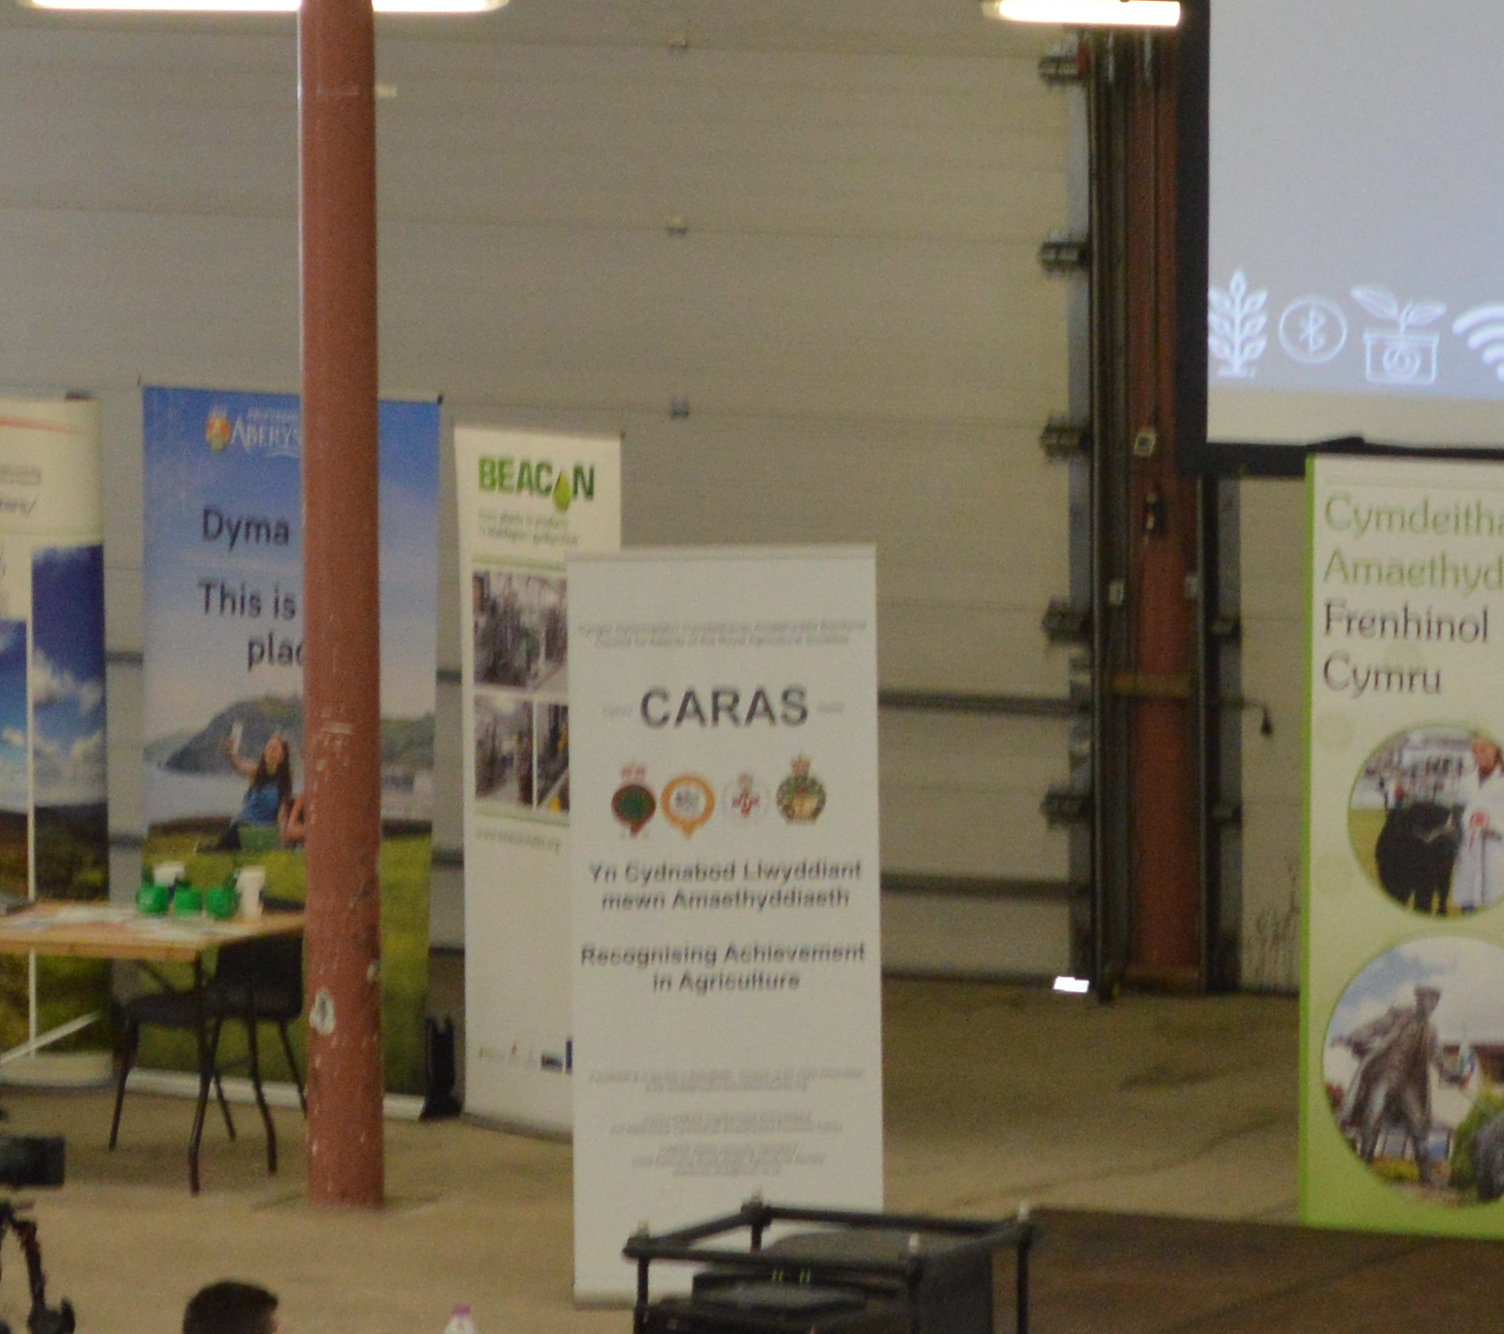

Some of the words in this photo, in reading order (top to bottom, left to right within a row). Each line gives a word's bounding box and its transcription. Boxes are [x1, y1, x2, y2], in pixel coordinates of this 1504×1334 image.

[202, 505, 291, 551] Dyma
[198, 578, 262, 617] This
[1322, 599, 1490, 644] Frenhinol
[1322, 652, 1442, 698] Cymru
[640, 684, 809, 729] CARAS
[589, 861, 618, 884] Yn
[625, 861, 736, 886] Cydnabod
[744, 859, 863, 885] Llwyddiant
[601, 890, 666, 910] mewn
[672, 887, 851, 913] Amaethyddiaeth
[581, 943, 718, 968] Recognising
[724, 941, 866, 965] Achievement
[652, 972, 672, 992] in
[678, 971, 801, 995] Agriculture
